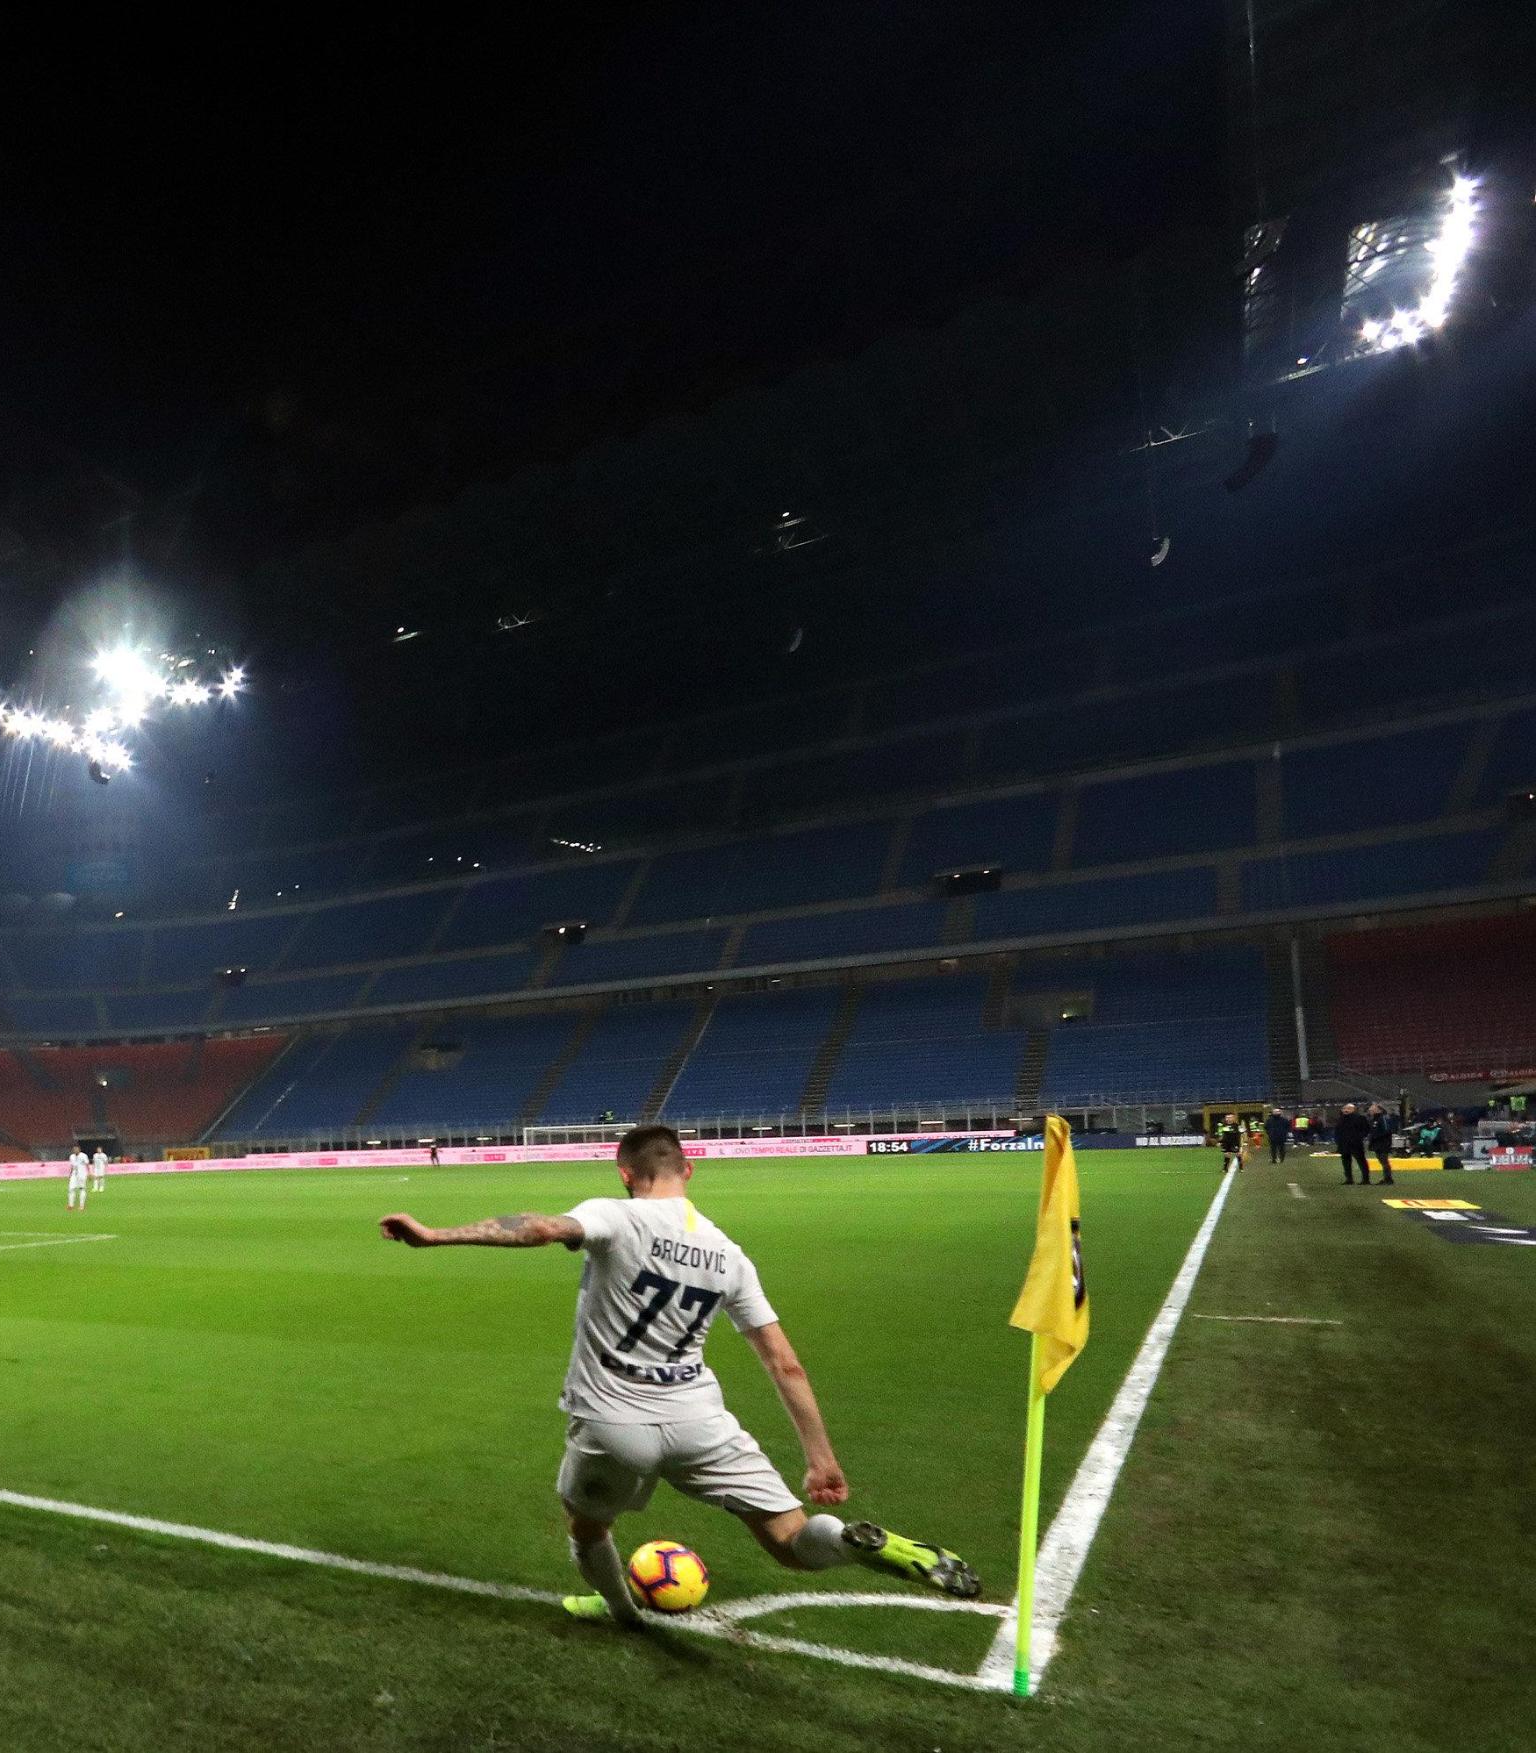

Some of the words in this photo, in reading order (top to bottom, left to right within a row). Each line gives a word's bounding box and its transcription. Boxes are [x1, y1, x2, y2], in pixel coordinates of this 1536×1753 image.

[869, 1141, 909, 1153] 18:54
[968, 1138, 1045, 1152] #ForzaIn
[616, 1270, 723, 1363] 77
